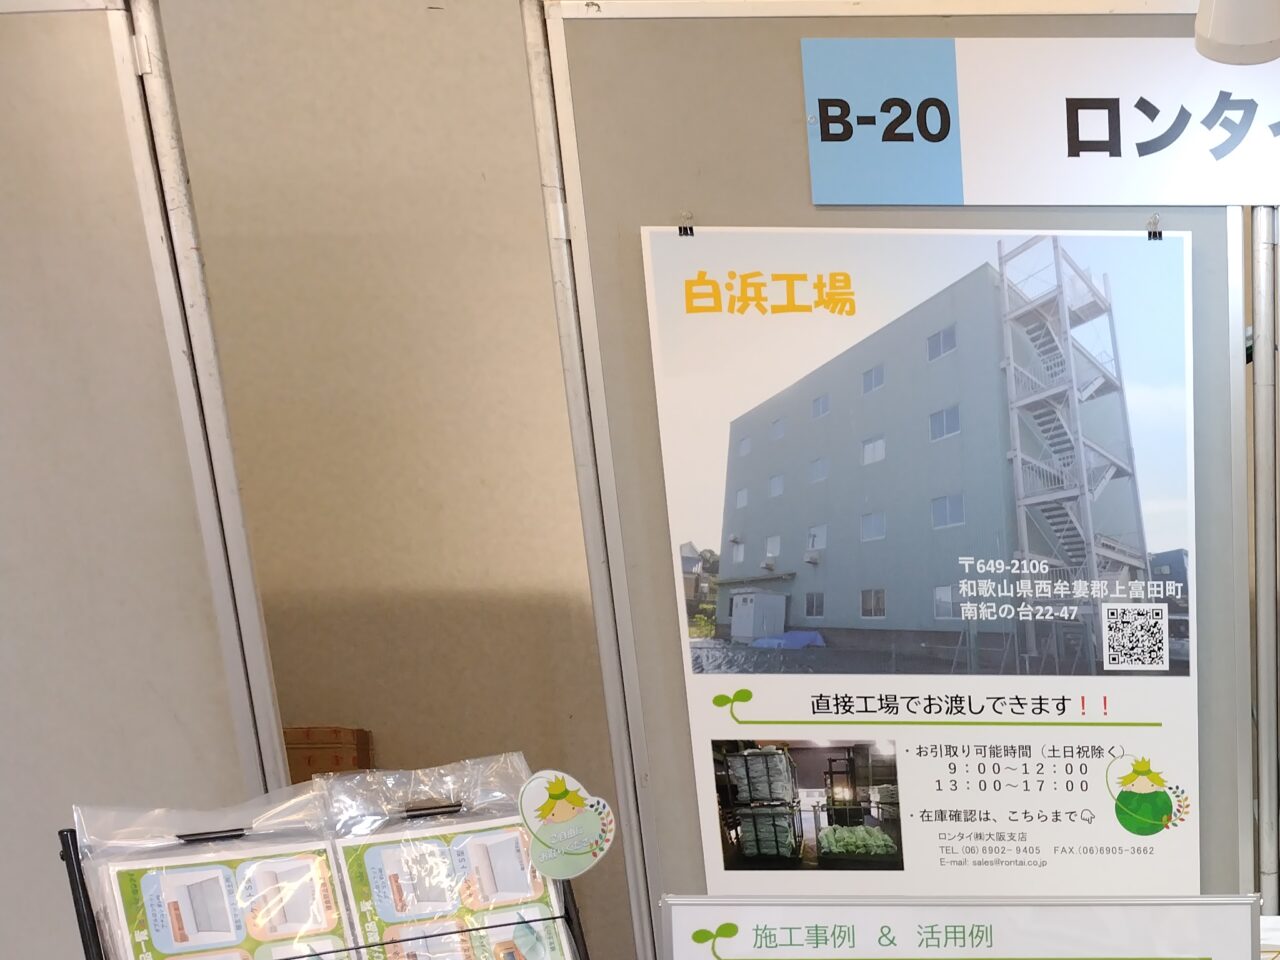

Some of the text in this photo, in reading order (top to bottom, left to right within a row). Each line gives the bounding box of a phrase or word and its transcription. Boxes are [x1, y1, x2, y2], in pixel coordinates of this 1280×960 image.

[818, 97, 951, 145] B-20
[684, 270, 857, 317] 白浜工場
[959, 579, 1184, 600] 和歌山県西牟婁郡上富田町
[960, 602, 1079, 621] 南紀の台22-47
[752, 923, 857, 950] 施工事例
[916, 923, 994, 949] 活用例
